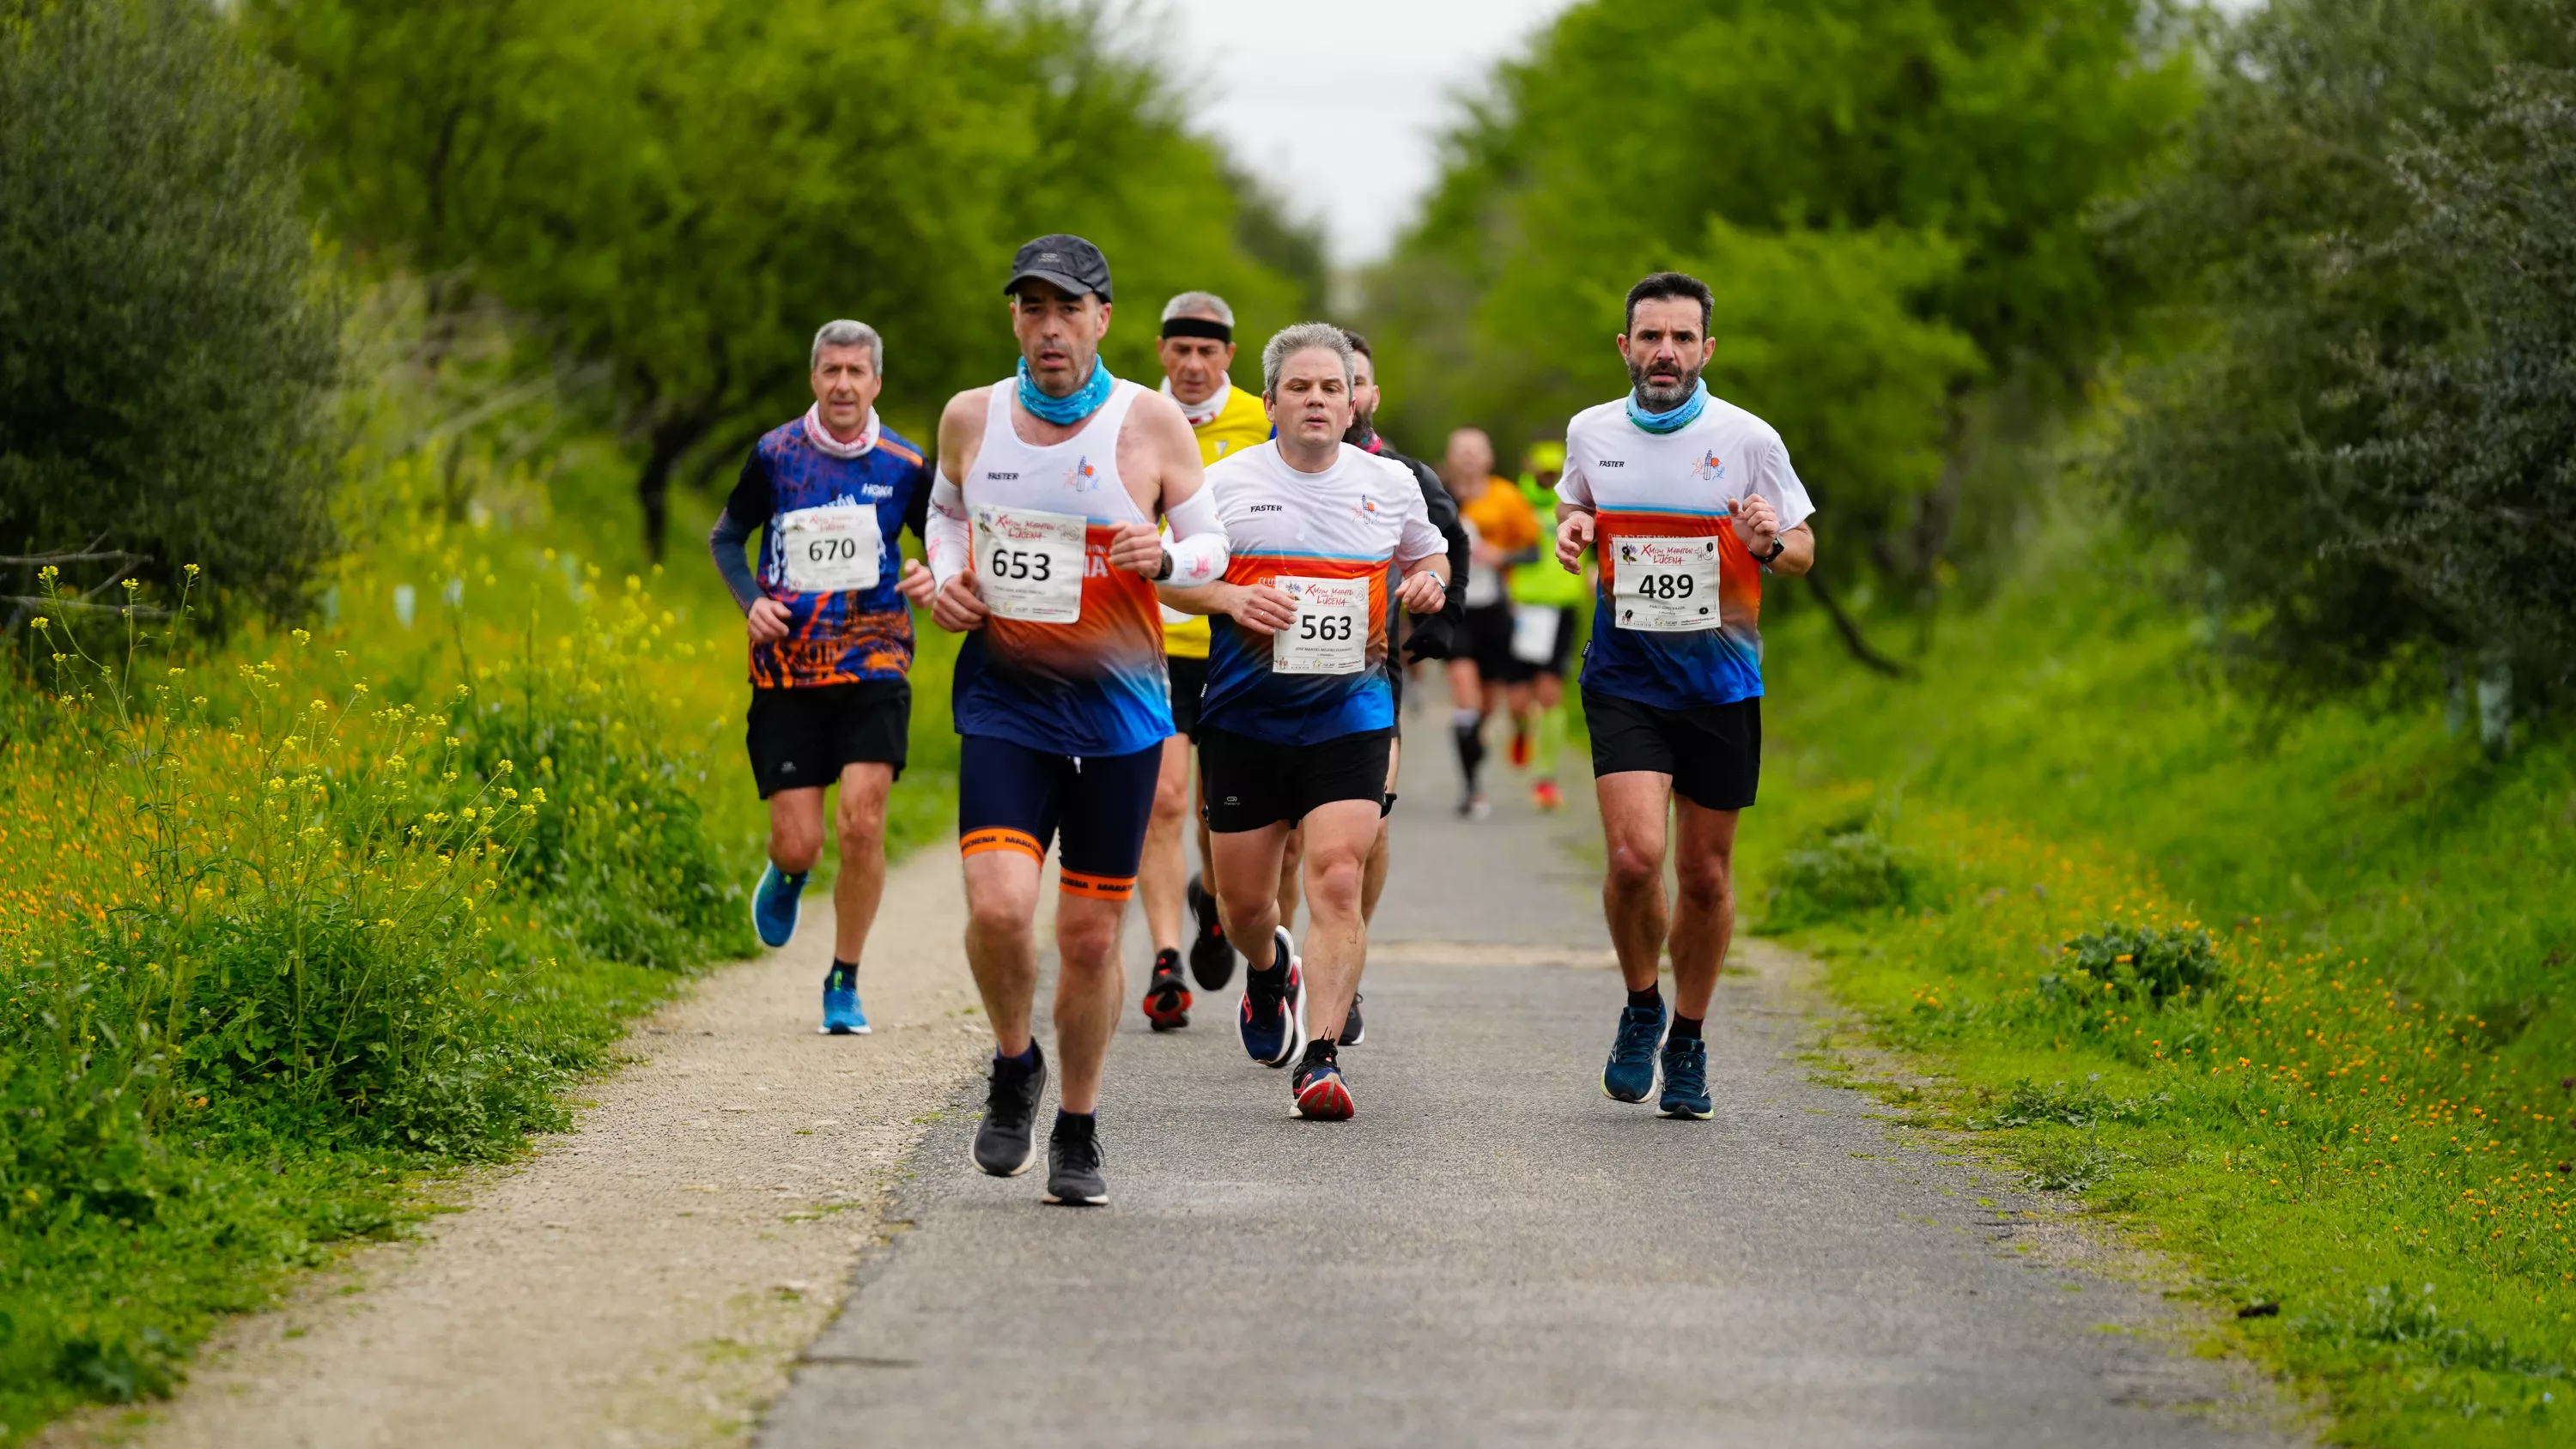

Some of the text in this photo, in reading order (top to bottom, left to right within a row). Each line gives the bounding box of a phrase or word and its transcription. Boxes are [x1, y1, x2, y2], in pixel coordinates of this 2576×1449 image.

[987, 472, 1019, 481] FASTER
[861, 482, 894, 498] HOKA
[1250, 504, 1283, 512] FASTER
[809, 538, 856, 561] 670
[993, 549, 1051, 581] 653
[1653, 555, 1686, 565] LUCENA
[1638, 574, 1694, 599] 489
[1316, 597, 1349, 606] LUCENA
[1300, 615, 1352, 641] 563
